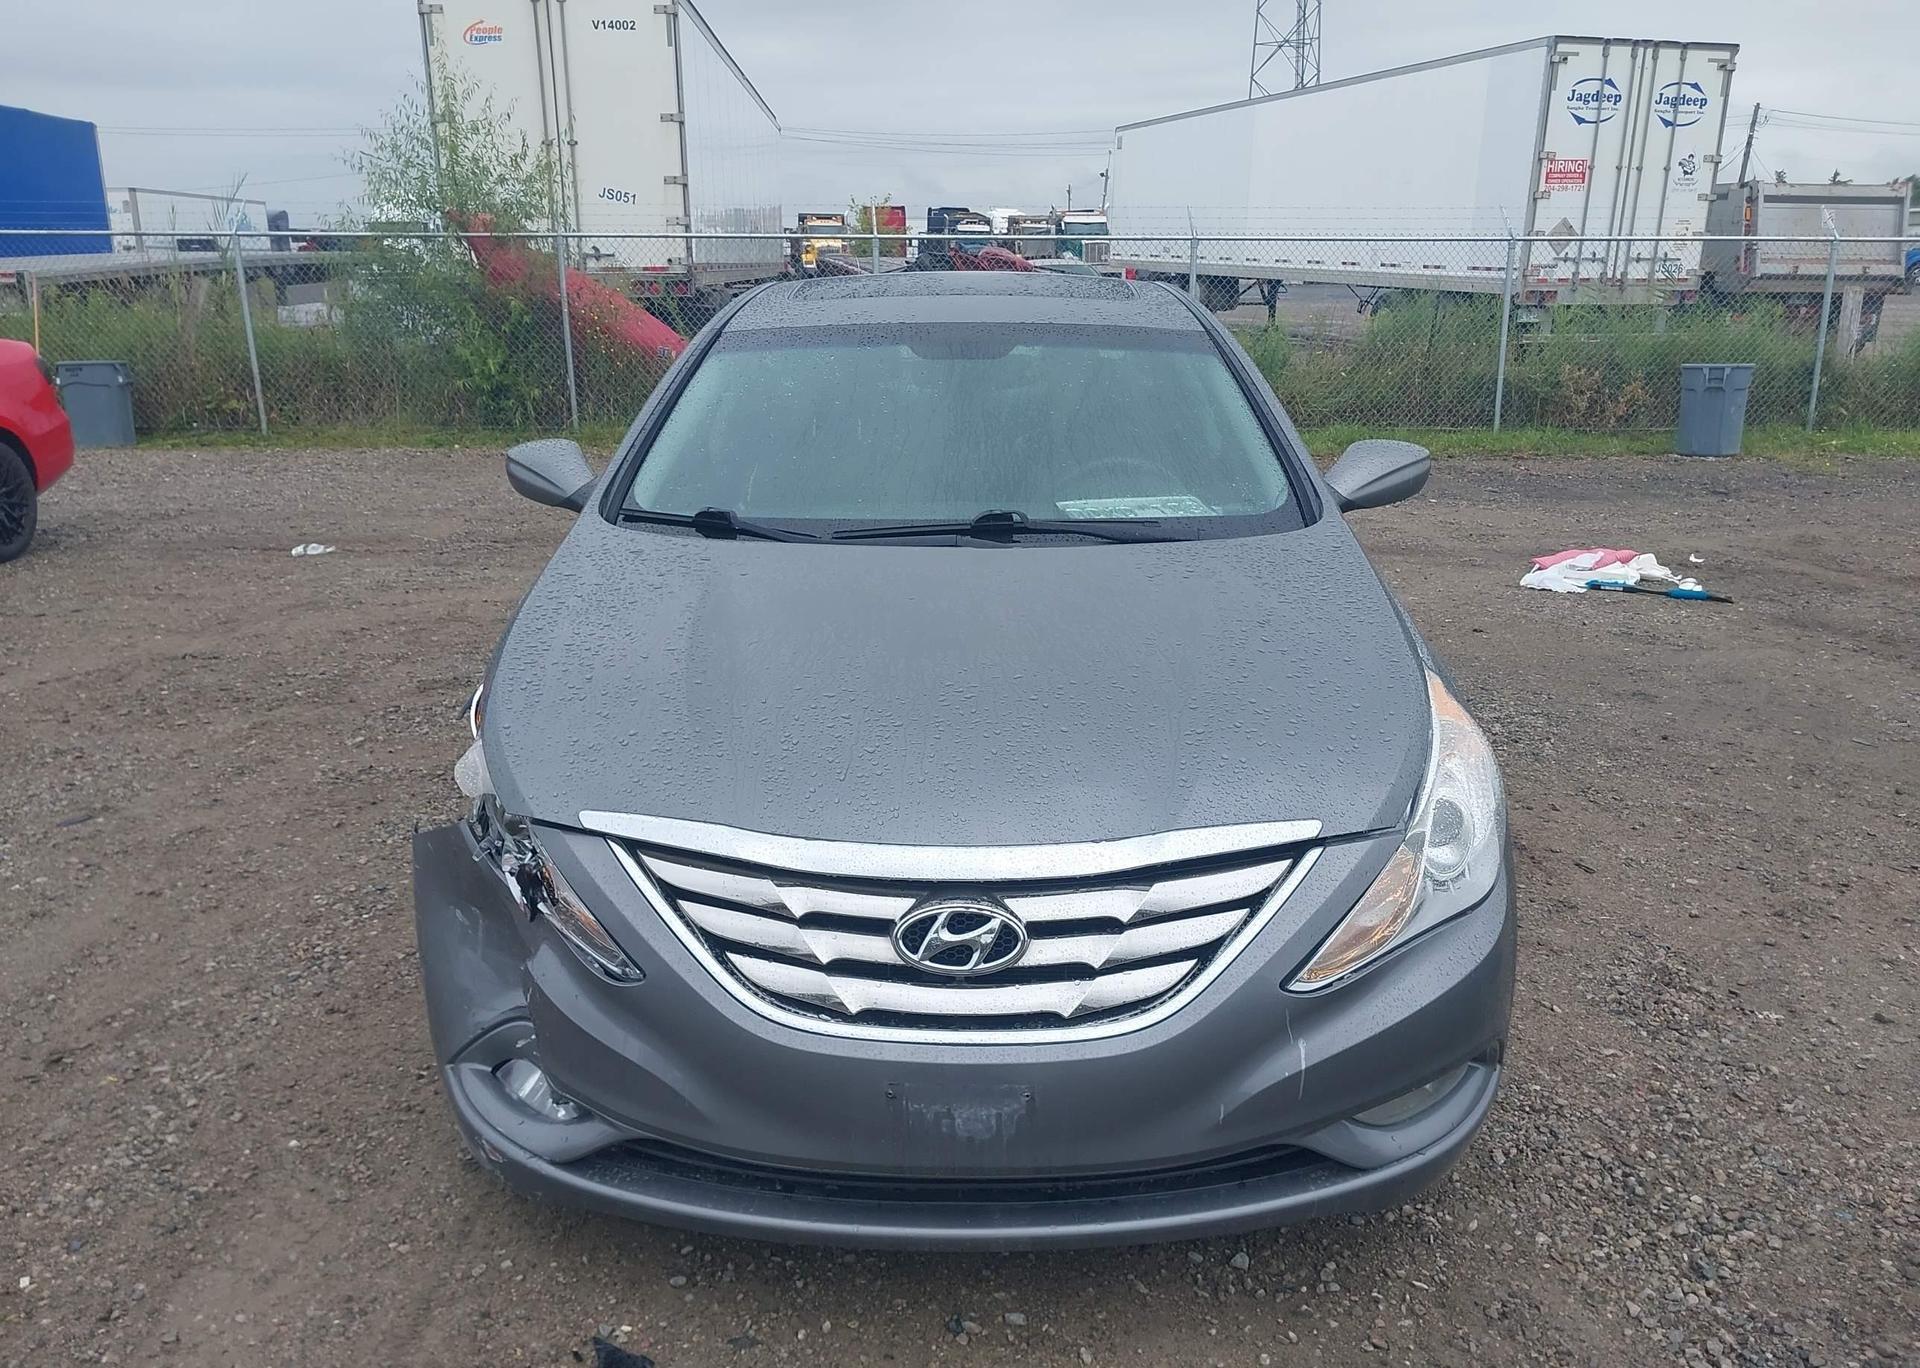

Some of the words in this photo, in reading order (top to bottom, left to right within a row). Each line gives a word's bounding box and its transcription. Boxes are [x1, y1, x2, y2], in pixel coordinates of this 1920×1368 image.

[470, 25, 503, 35] People
[591, 19, 636, 30] V14002
[469, 34, 502, 42] Express
[1567, 89, 1622, 105] Jagdeep
[1655, 92, 1708, 109] Jagdeep
[1547, 160, 1586, 173] HIRING!
[598, 187, 636, 205] JS051
